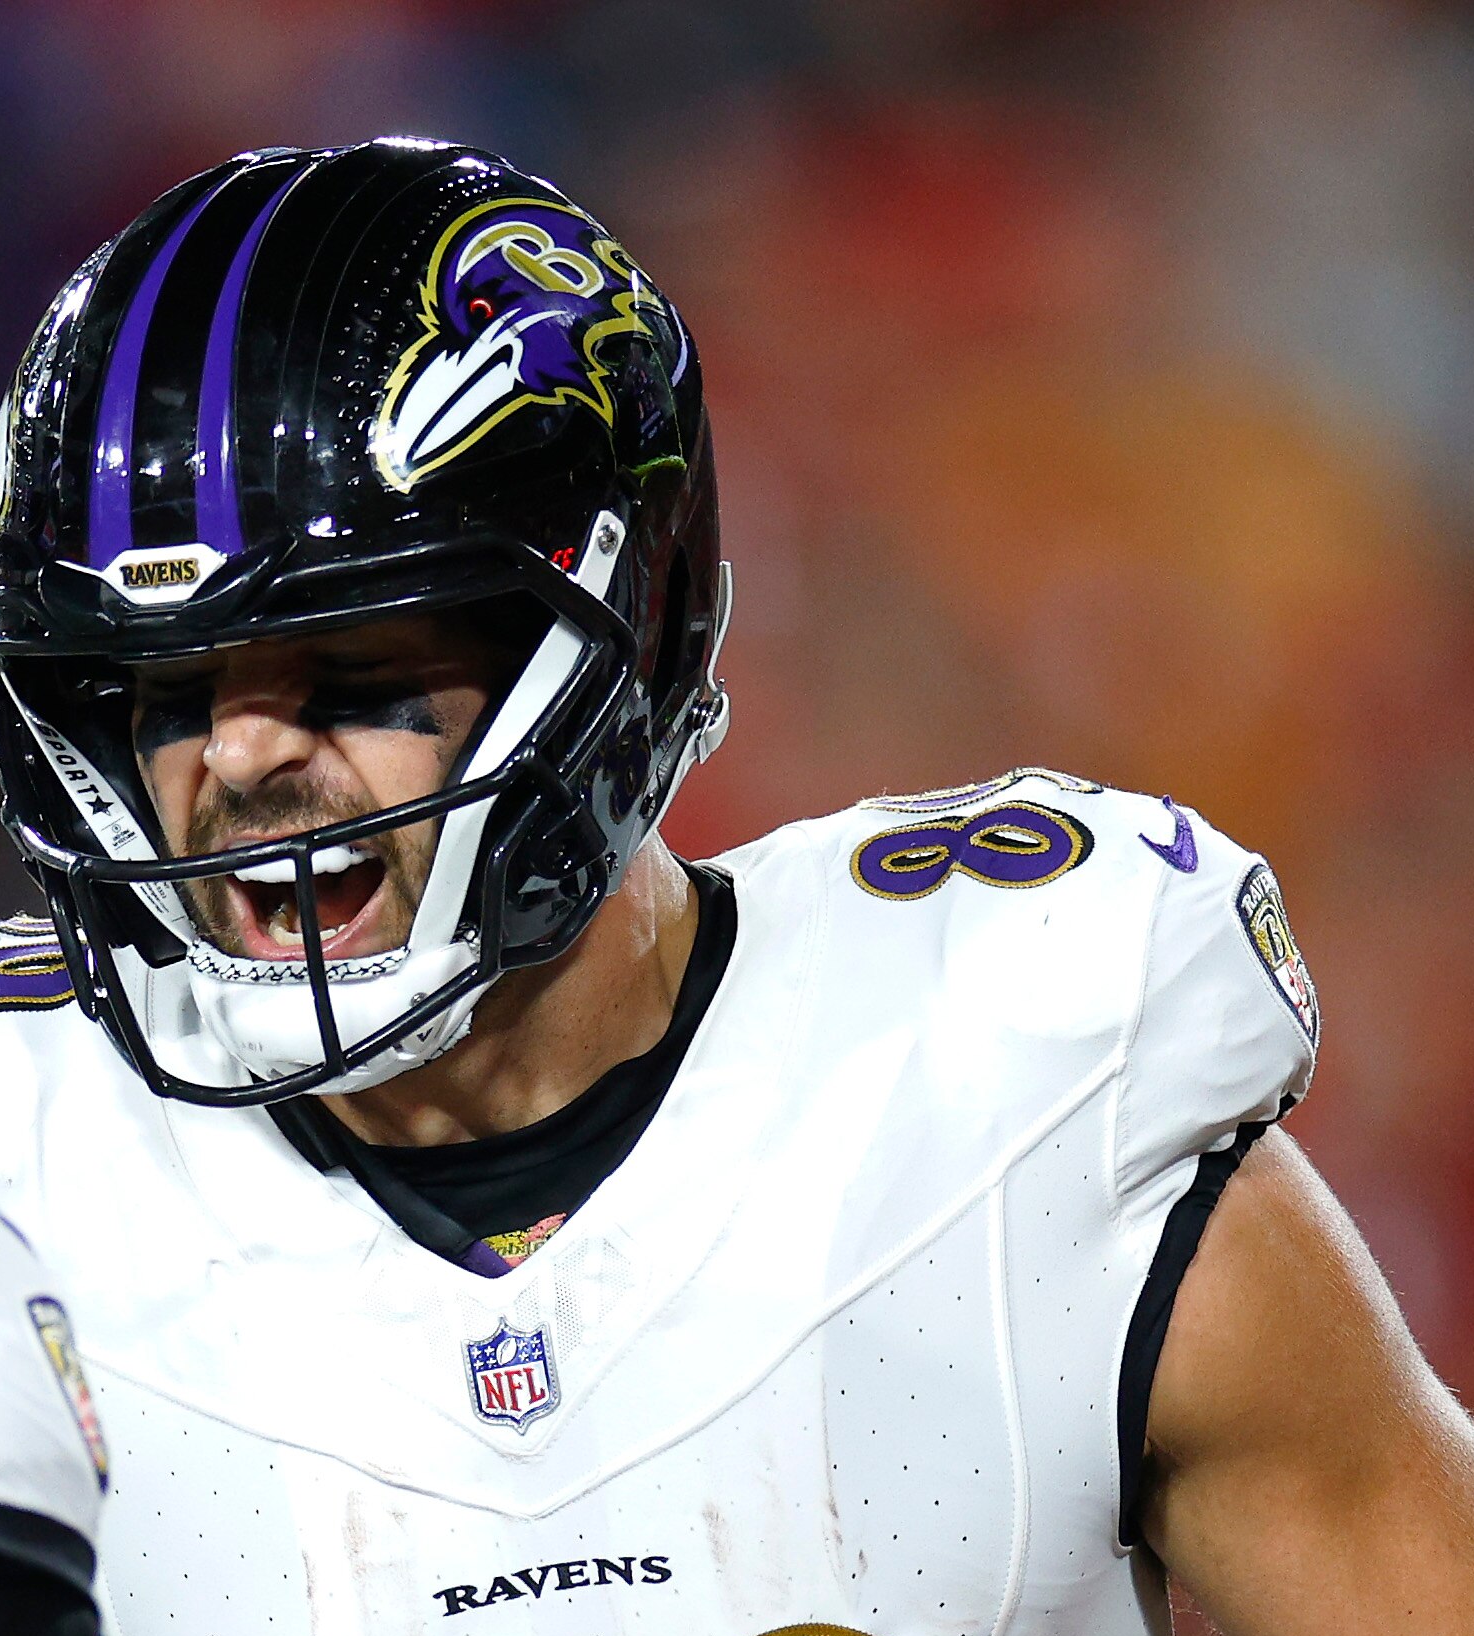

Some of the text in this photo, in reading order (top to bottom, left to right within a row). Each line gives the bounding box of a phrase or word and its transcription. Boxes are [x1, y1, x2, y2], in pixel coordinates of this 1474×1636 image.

[119, 558, 200, 587] RAVENS
[36, 721, 99, 796] SPORT
[481, 1367, 546, 1411] NFL
[434, 1556, 672, 1617] RAVENS
